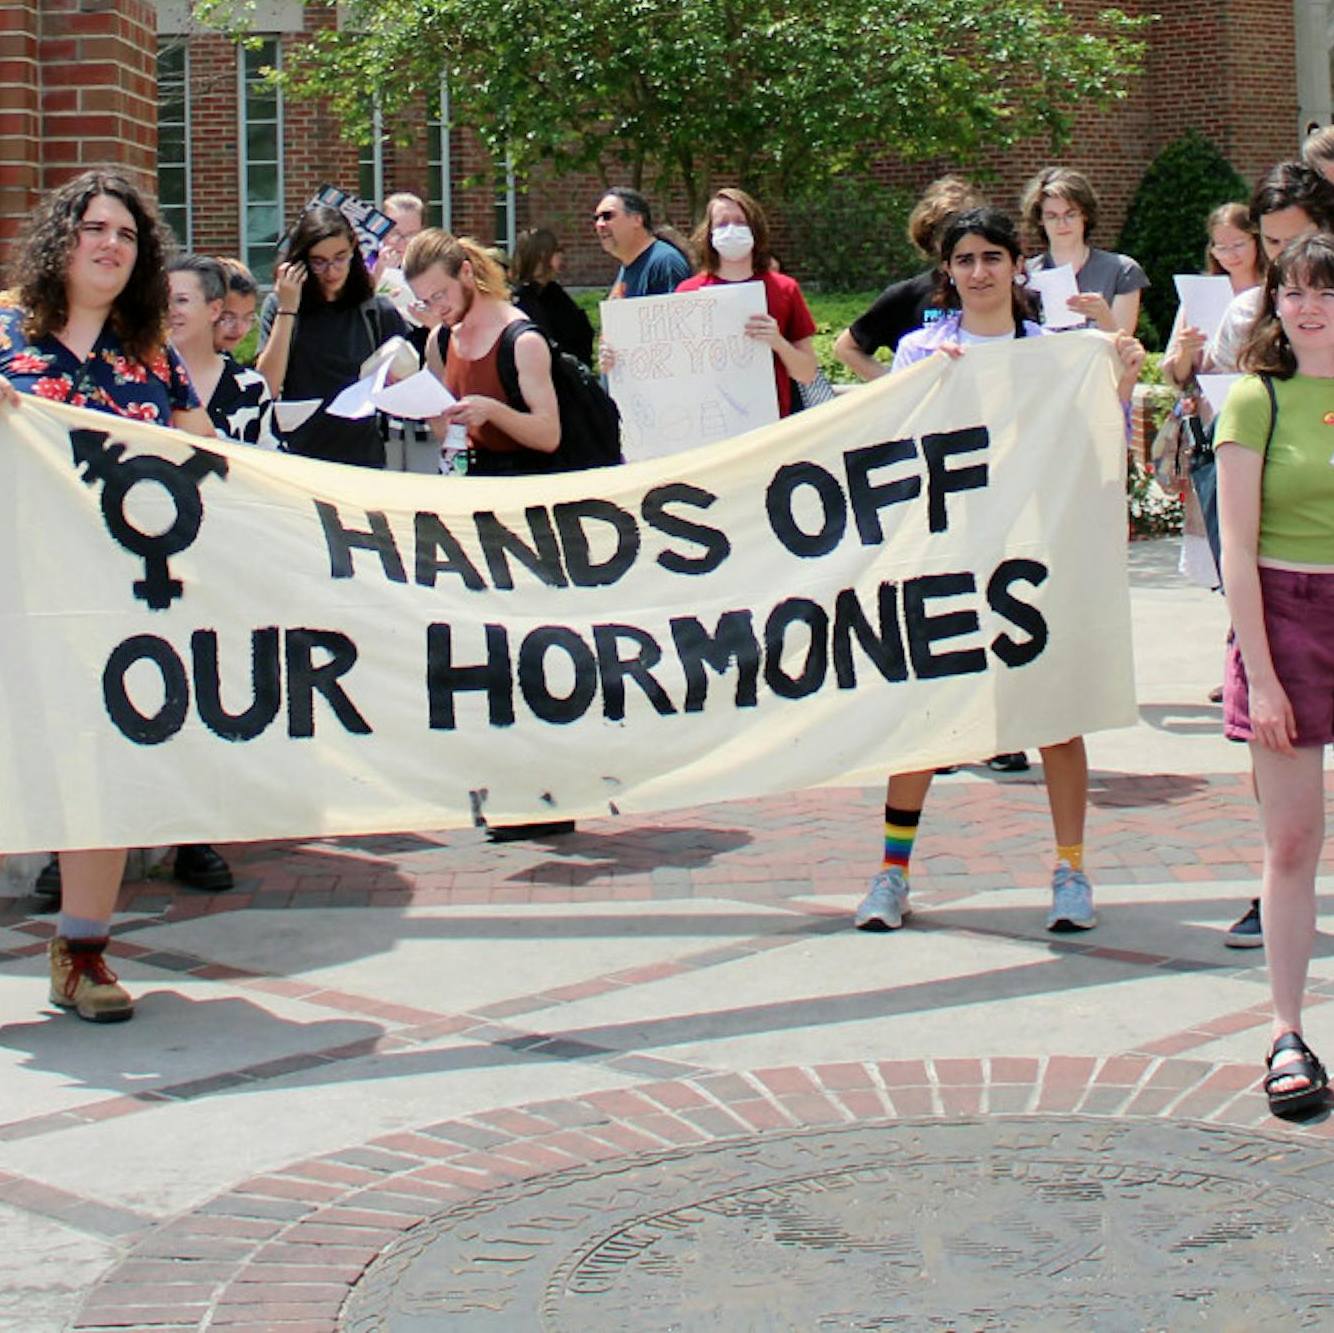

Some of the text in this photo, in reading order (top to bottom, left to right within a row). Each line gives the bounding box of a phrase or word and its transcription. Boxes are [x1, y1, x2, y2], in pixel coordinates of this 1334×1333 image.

[612, 334, 756, 384] FOR YOU
[314, 424, 990, 593] HANDS OFF
[102, 557, 1050, 746] OUR HORMONES
